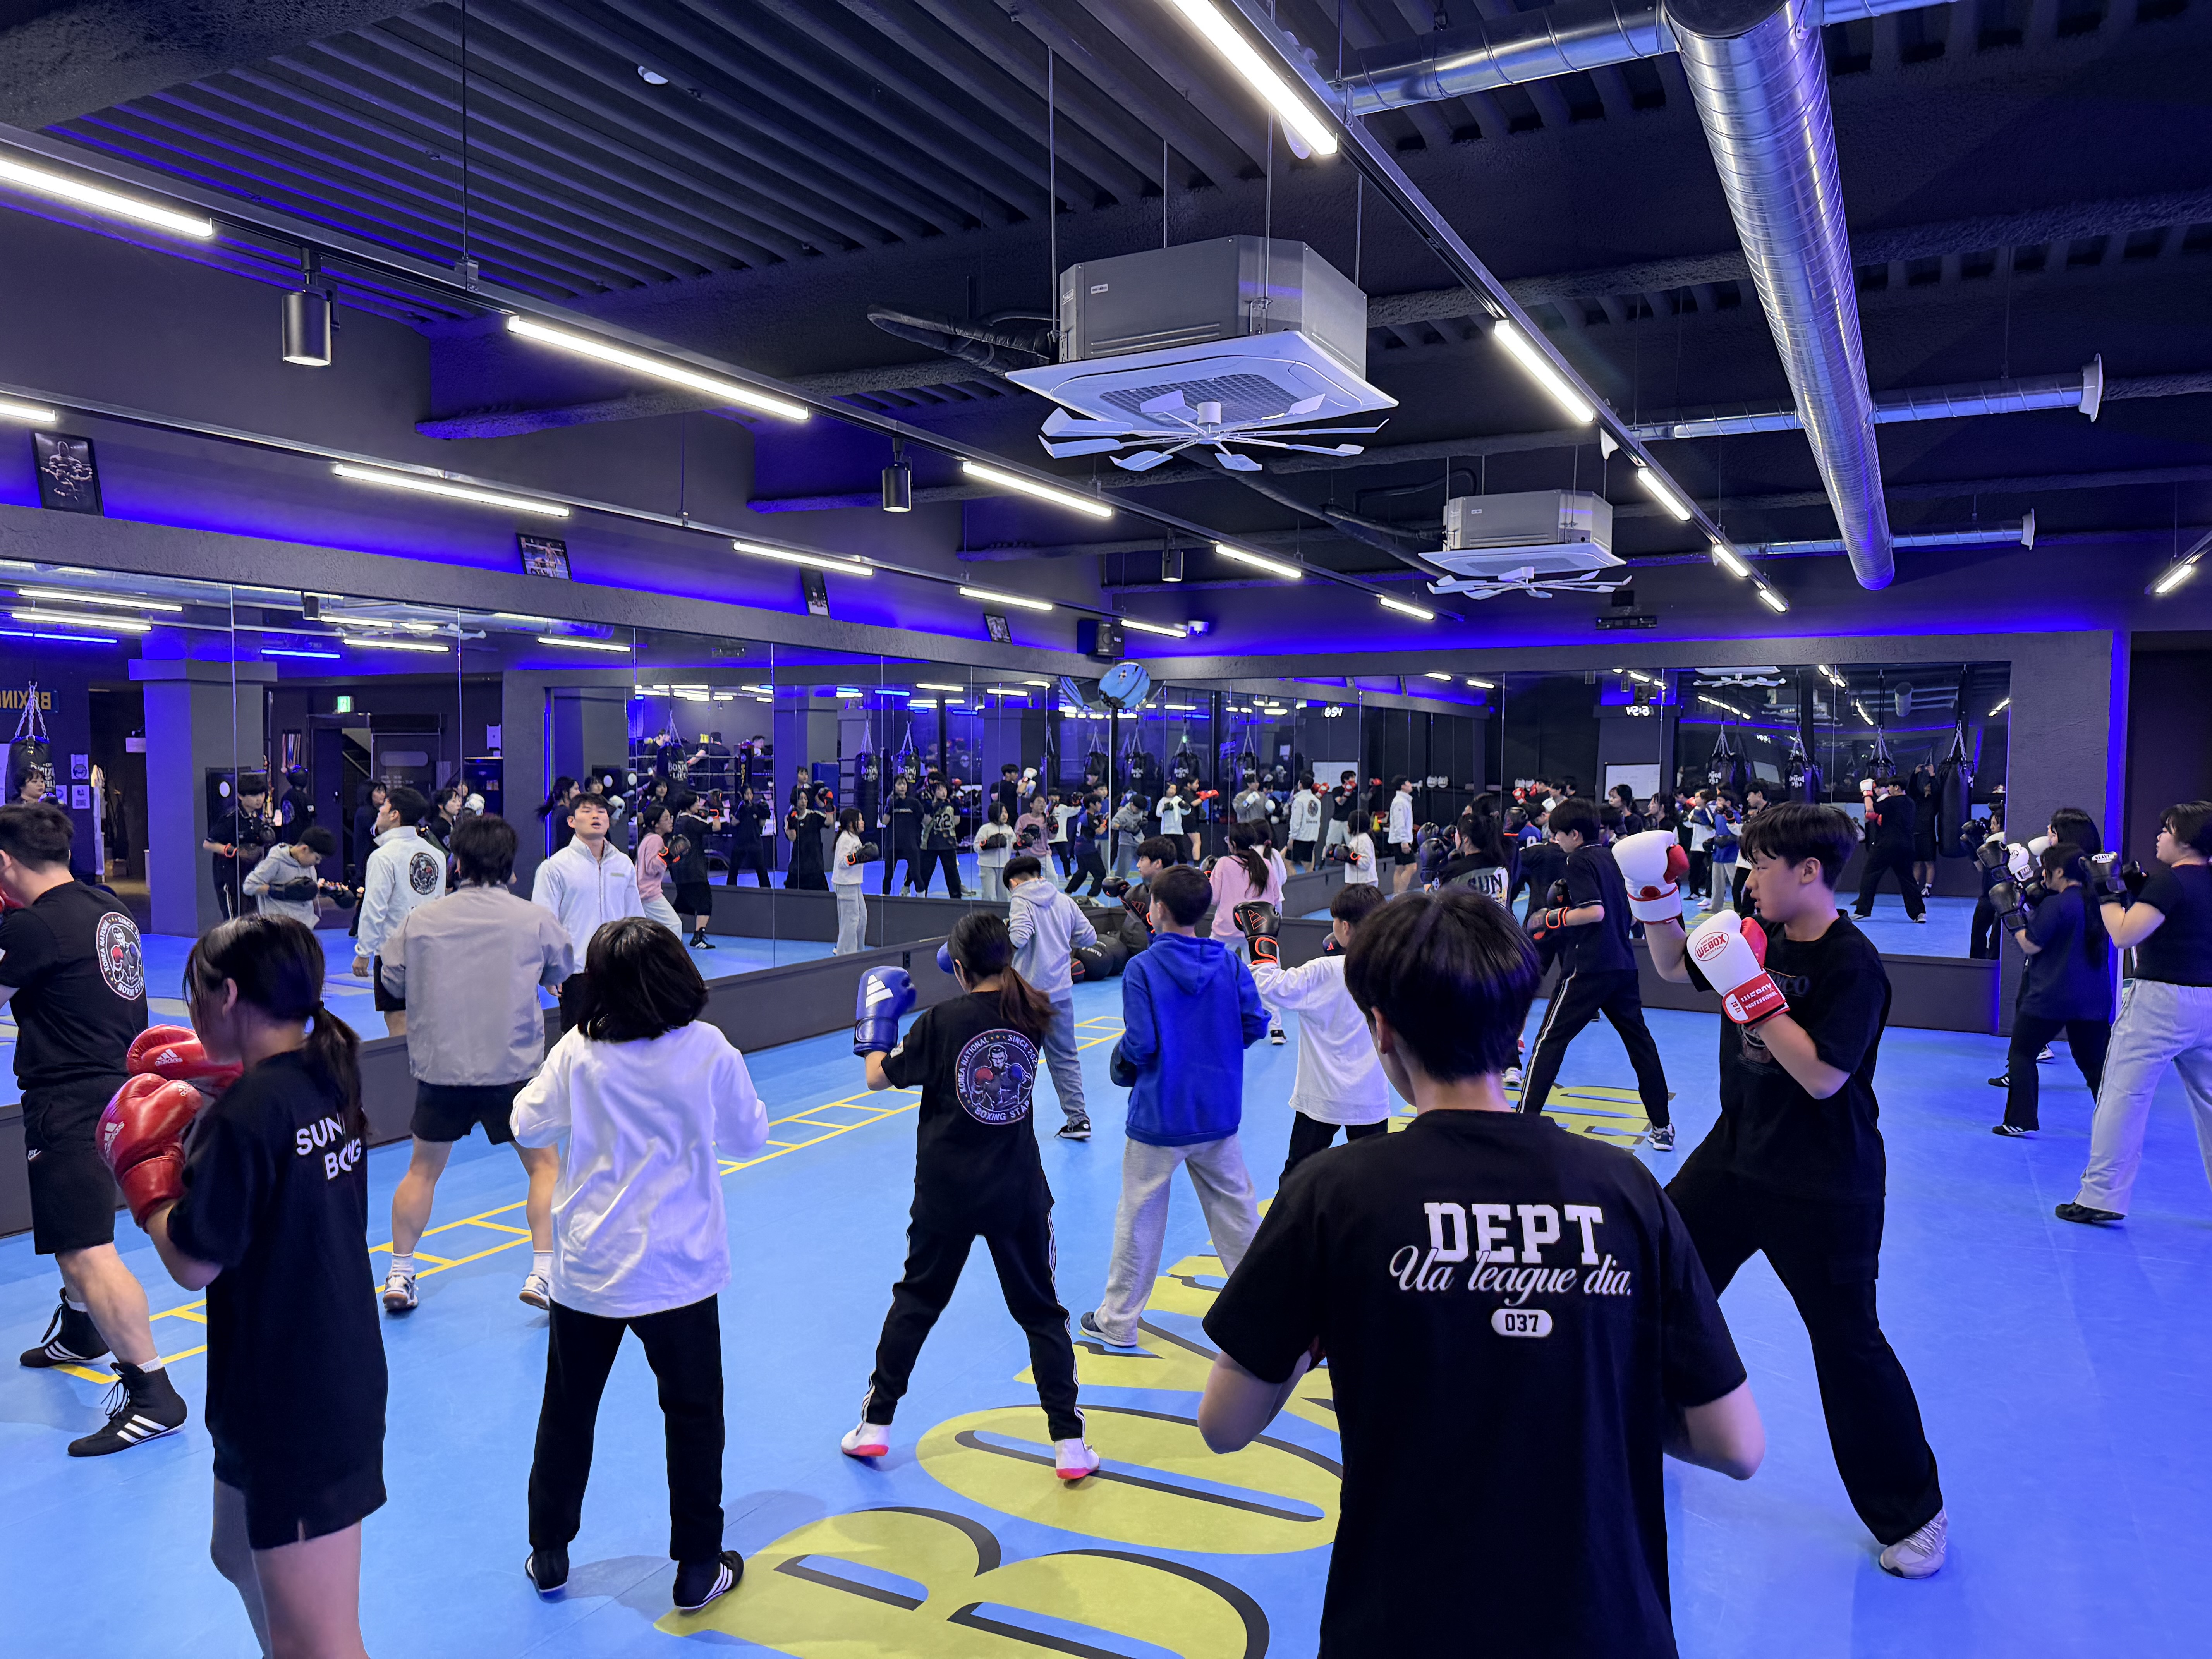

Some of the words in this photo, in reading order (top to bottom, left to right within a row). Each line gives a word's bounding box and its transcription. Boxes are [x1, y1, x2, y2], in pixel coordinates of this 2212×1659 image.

[1696, 934, 1726, 958] WEBOX
[960, 1037, 990, 1066] NATIONAL
[1008, 1034, 1029, 1049] SINCE
[1027, 1049, 1038, 1065] 202
[958, 1067, 967, 1093] KOREA
[974, 1106, 1006, 1121] BOXING
[1424, 1202, 1604, 1265] DEPT
[1468, 1250, 1578, 1306] league
[1583, 1254, 1632, 1295] dia.
[1504, 1313, 1539, 1332] 037
